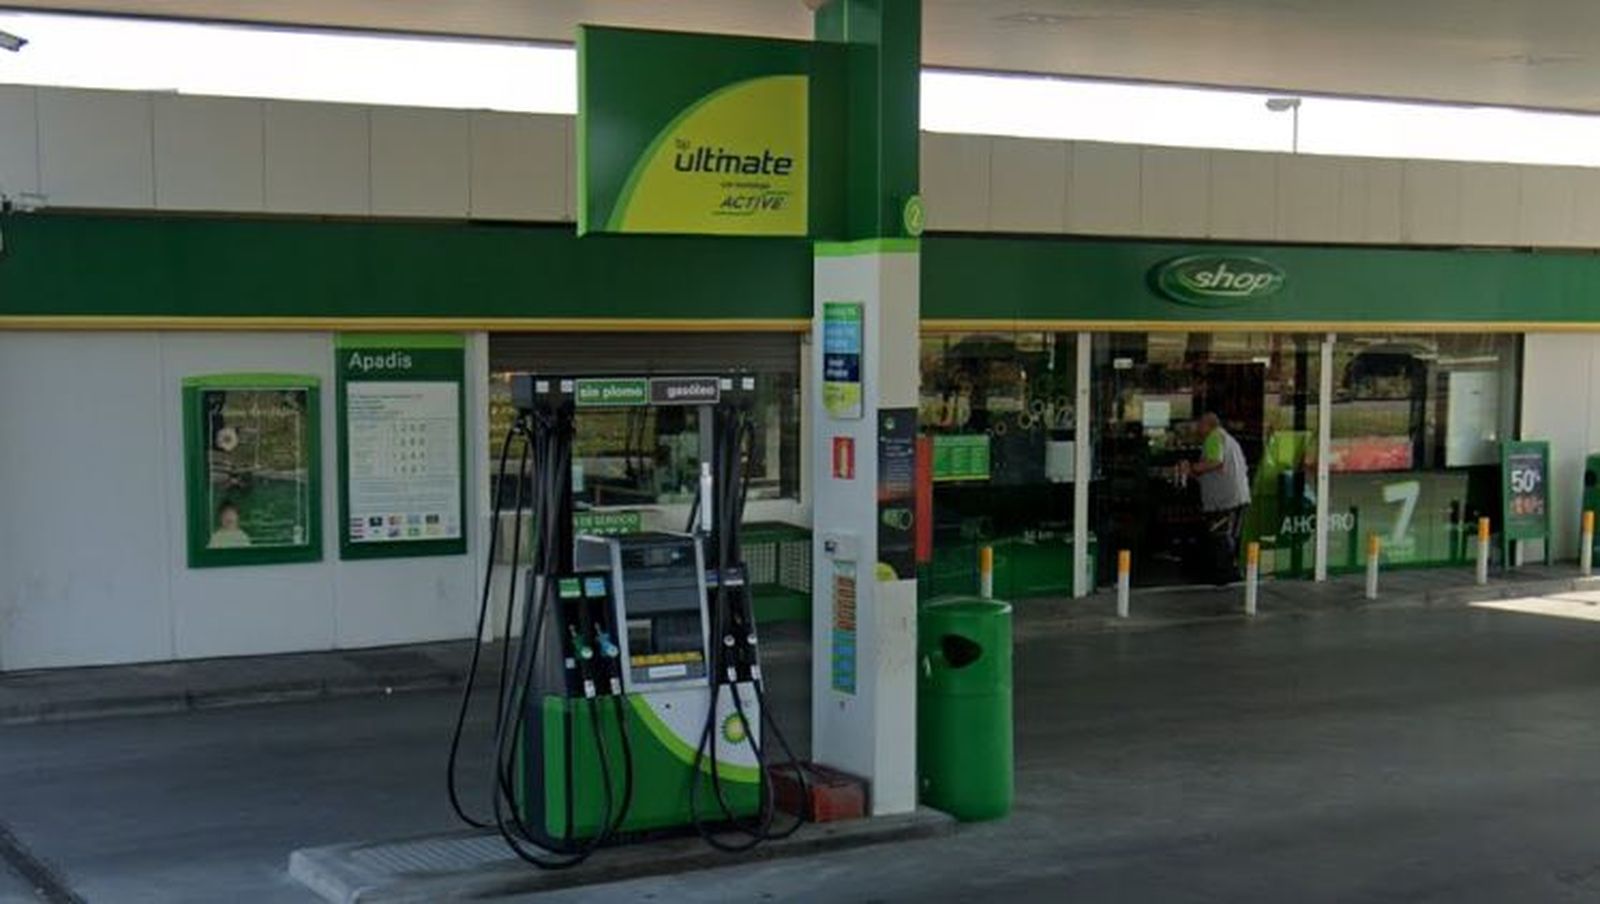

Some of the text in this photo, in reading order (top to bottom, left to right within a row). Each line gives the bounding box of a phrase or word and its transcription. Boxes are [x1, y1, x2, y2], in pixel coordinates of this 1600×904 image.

[674, 147, 793, 176] ultimate
[719, 196, 786, 211] ACTIVE
[1194, 262, 1273, 297] shop
[348, 351, 413, 372] Apadis
[580, 385, 643, 400] sin plomo
[667, 383, 715, 399] gasóleo
[1281, 513, 1355, 534] AHORO
